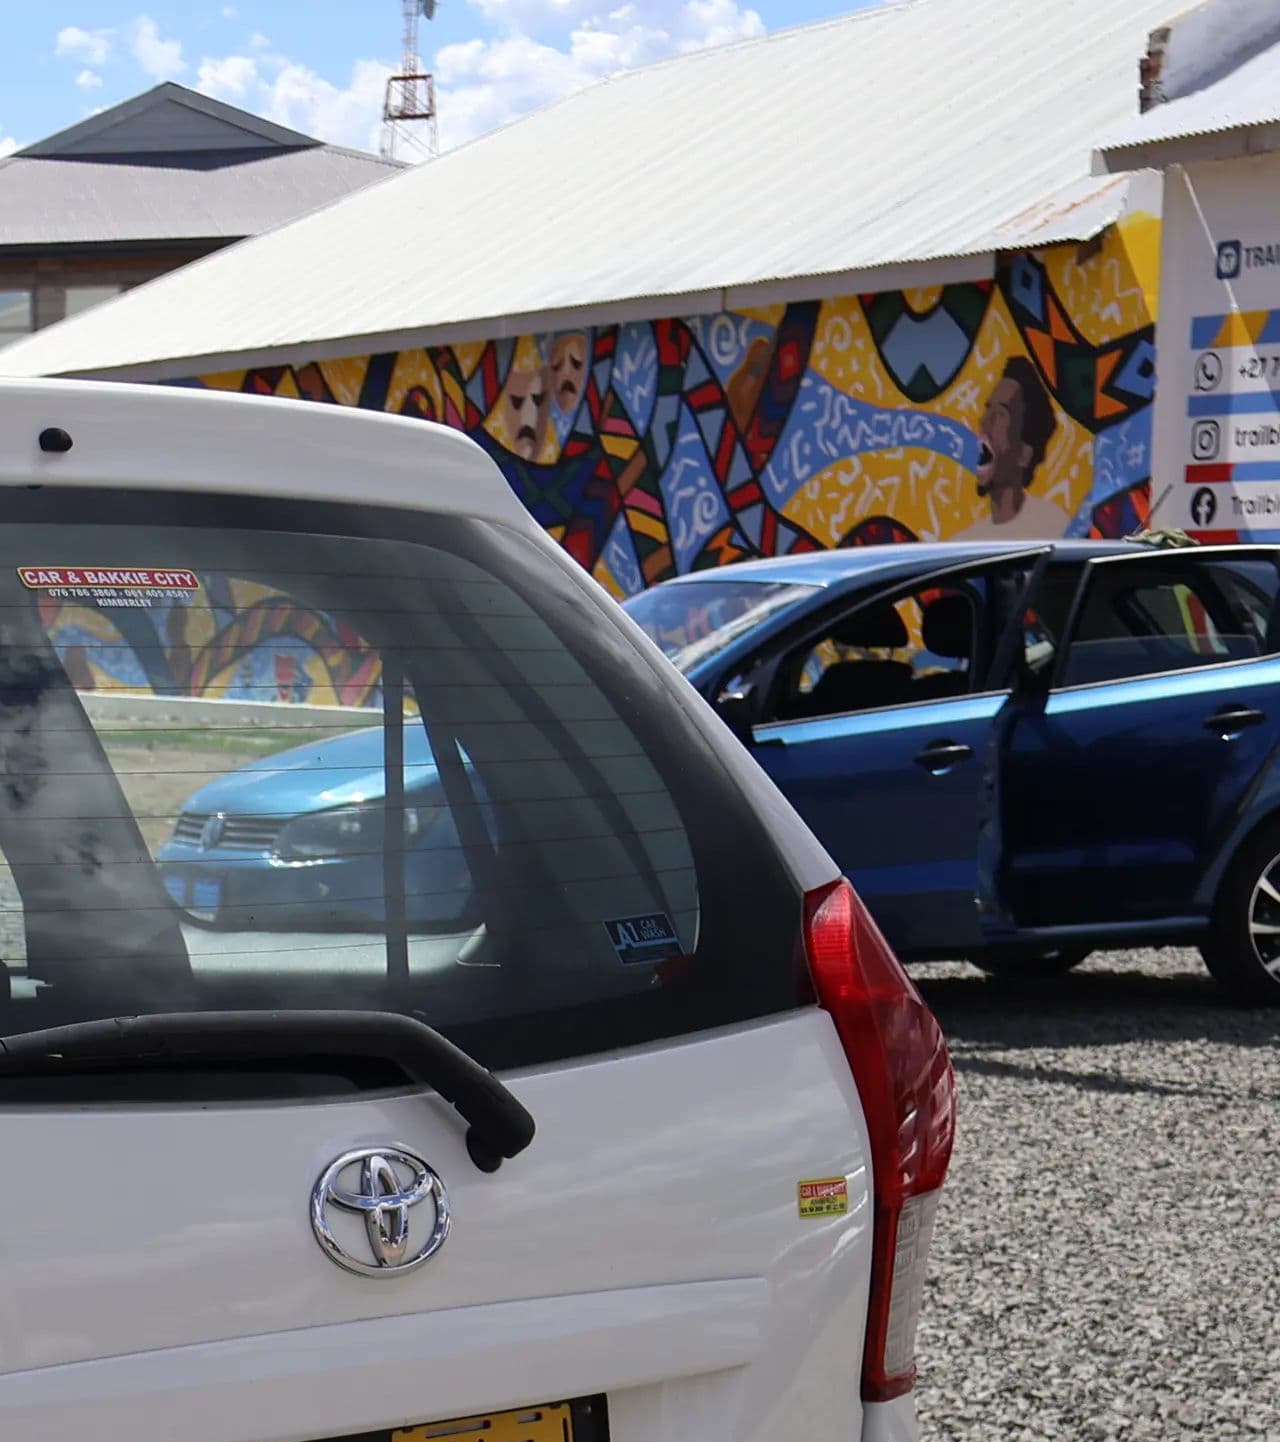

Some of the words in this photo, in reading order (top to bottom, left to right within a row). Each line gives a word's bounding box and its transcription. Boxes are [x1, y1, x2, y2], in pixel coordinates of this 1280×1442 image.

[24, 571, 63, 585] CAR
[68, 571, 82, 584] &
[85, 571, 152, 586] BAKKIE
[154, 573, 194, 587] CITY
[97, 598, 153, 608] KIMBERLEY
